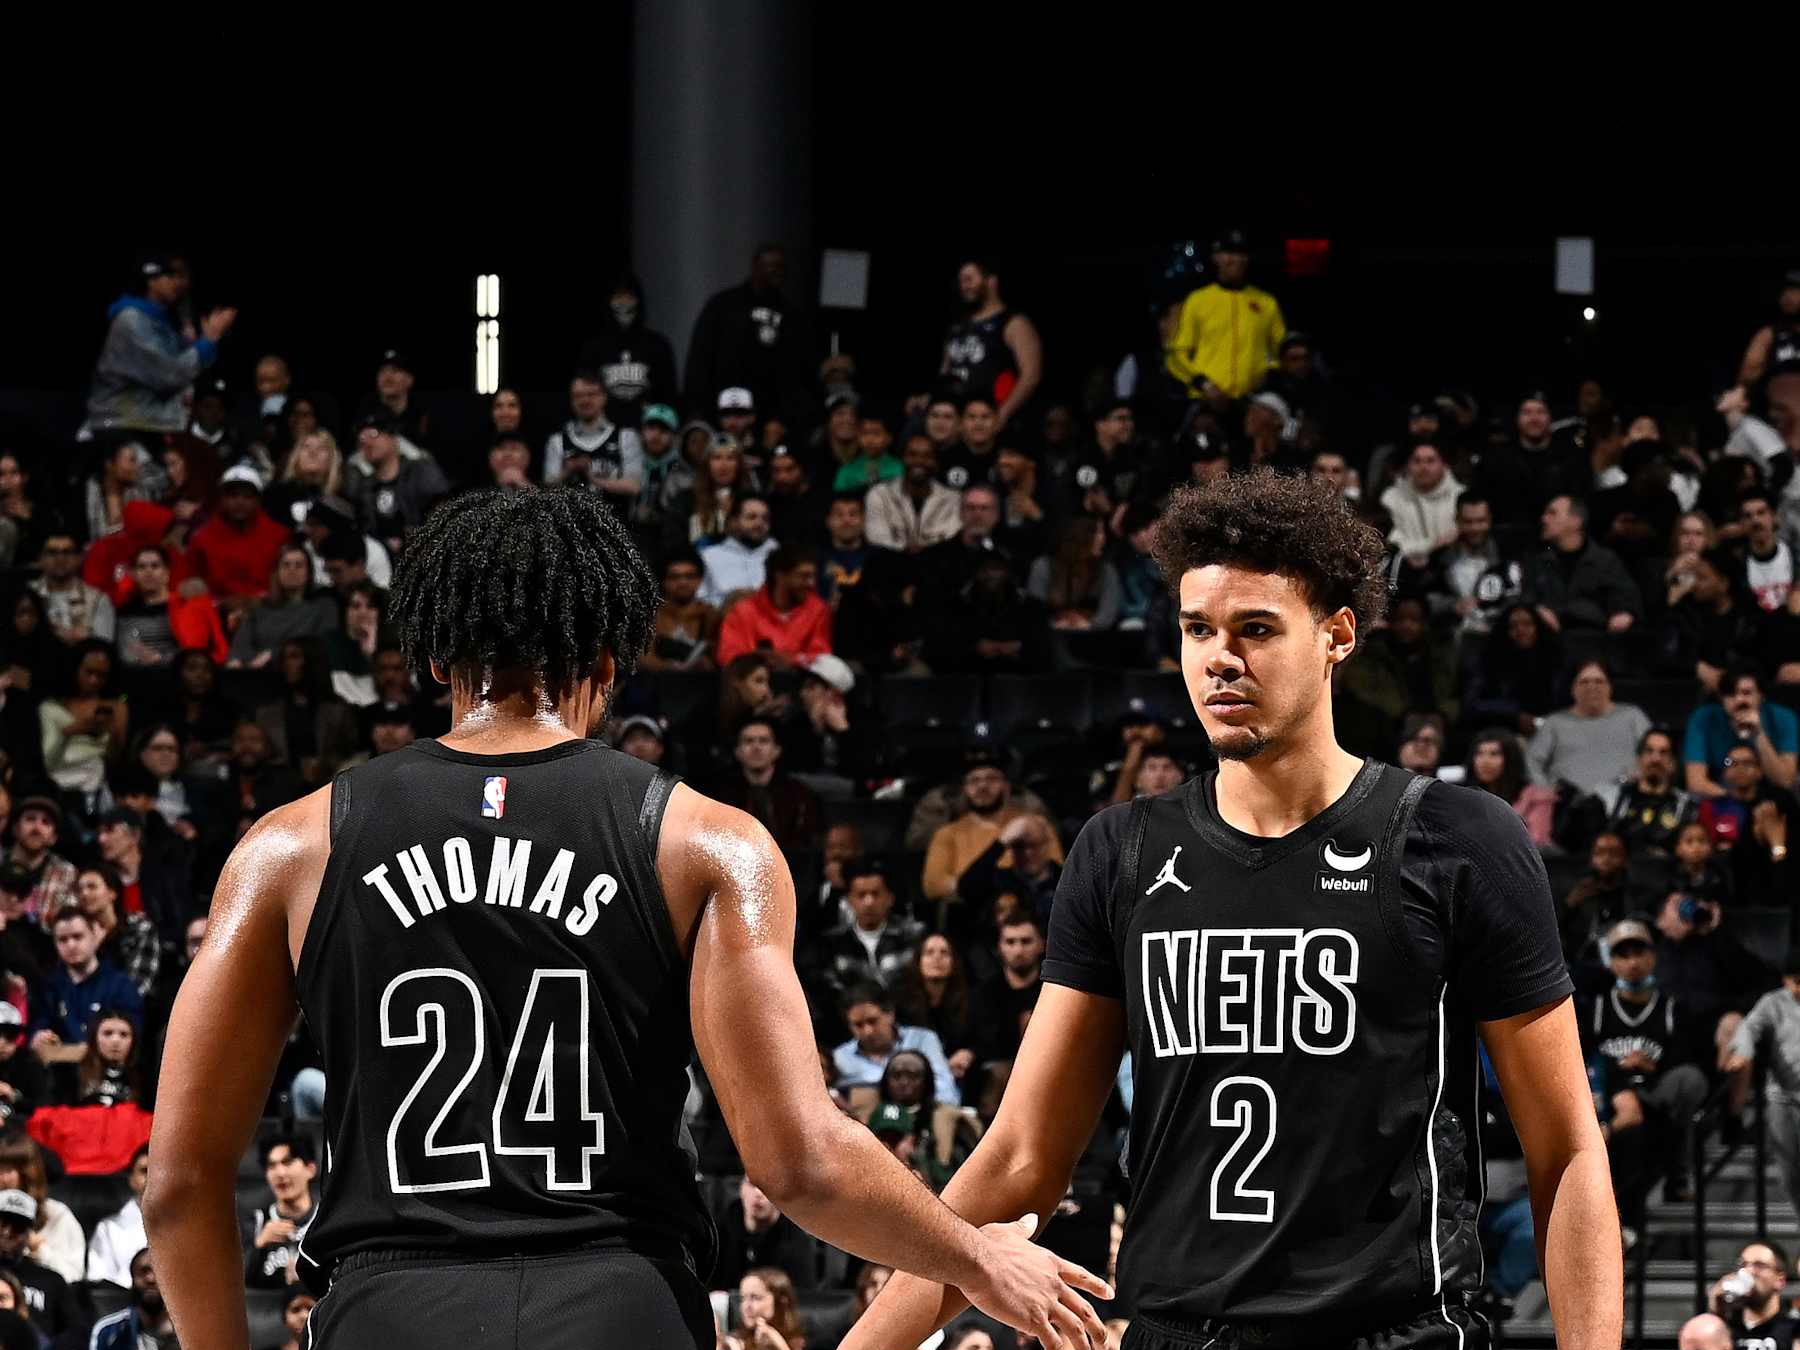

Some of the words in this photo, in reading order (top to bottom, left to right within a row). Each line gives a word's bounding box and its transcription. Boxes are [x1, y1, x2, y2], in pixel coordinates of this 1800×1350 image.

[362, 836, 618, 936] THOMAS
[1321, 877, 1368, 892] Webull
[1141, 928, 1359, 1058] NETS
[379, 967, 605, 1194] 24
[1209, 1075, 1277, 1223] 2
